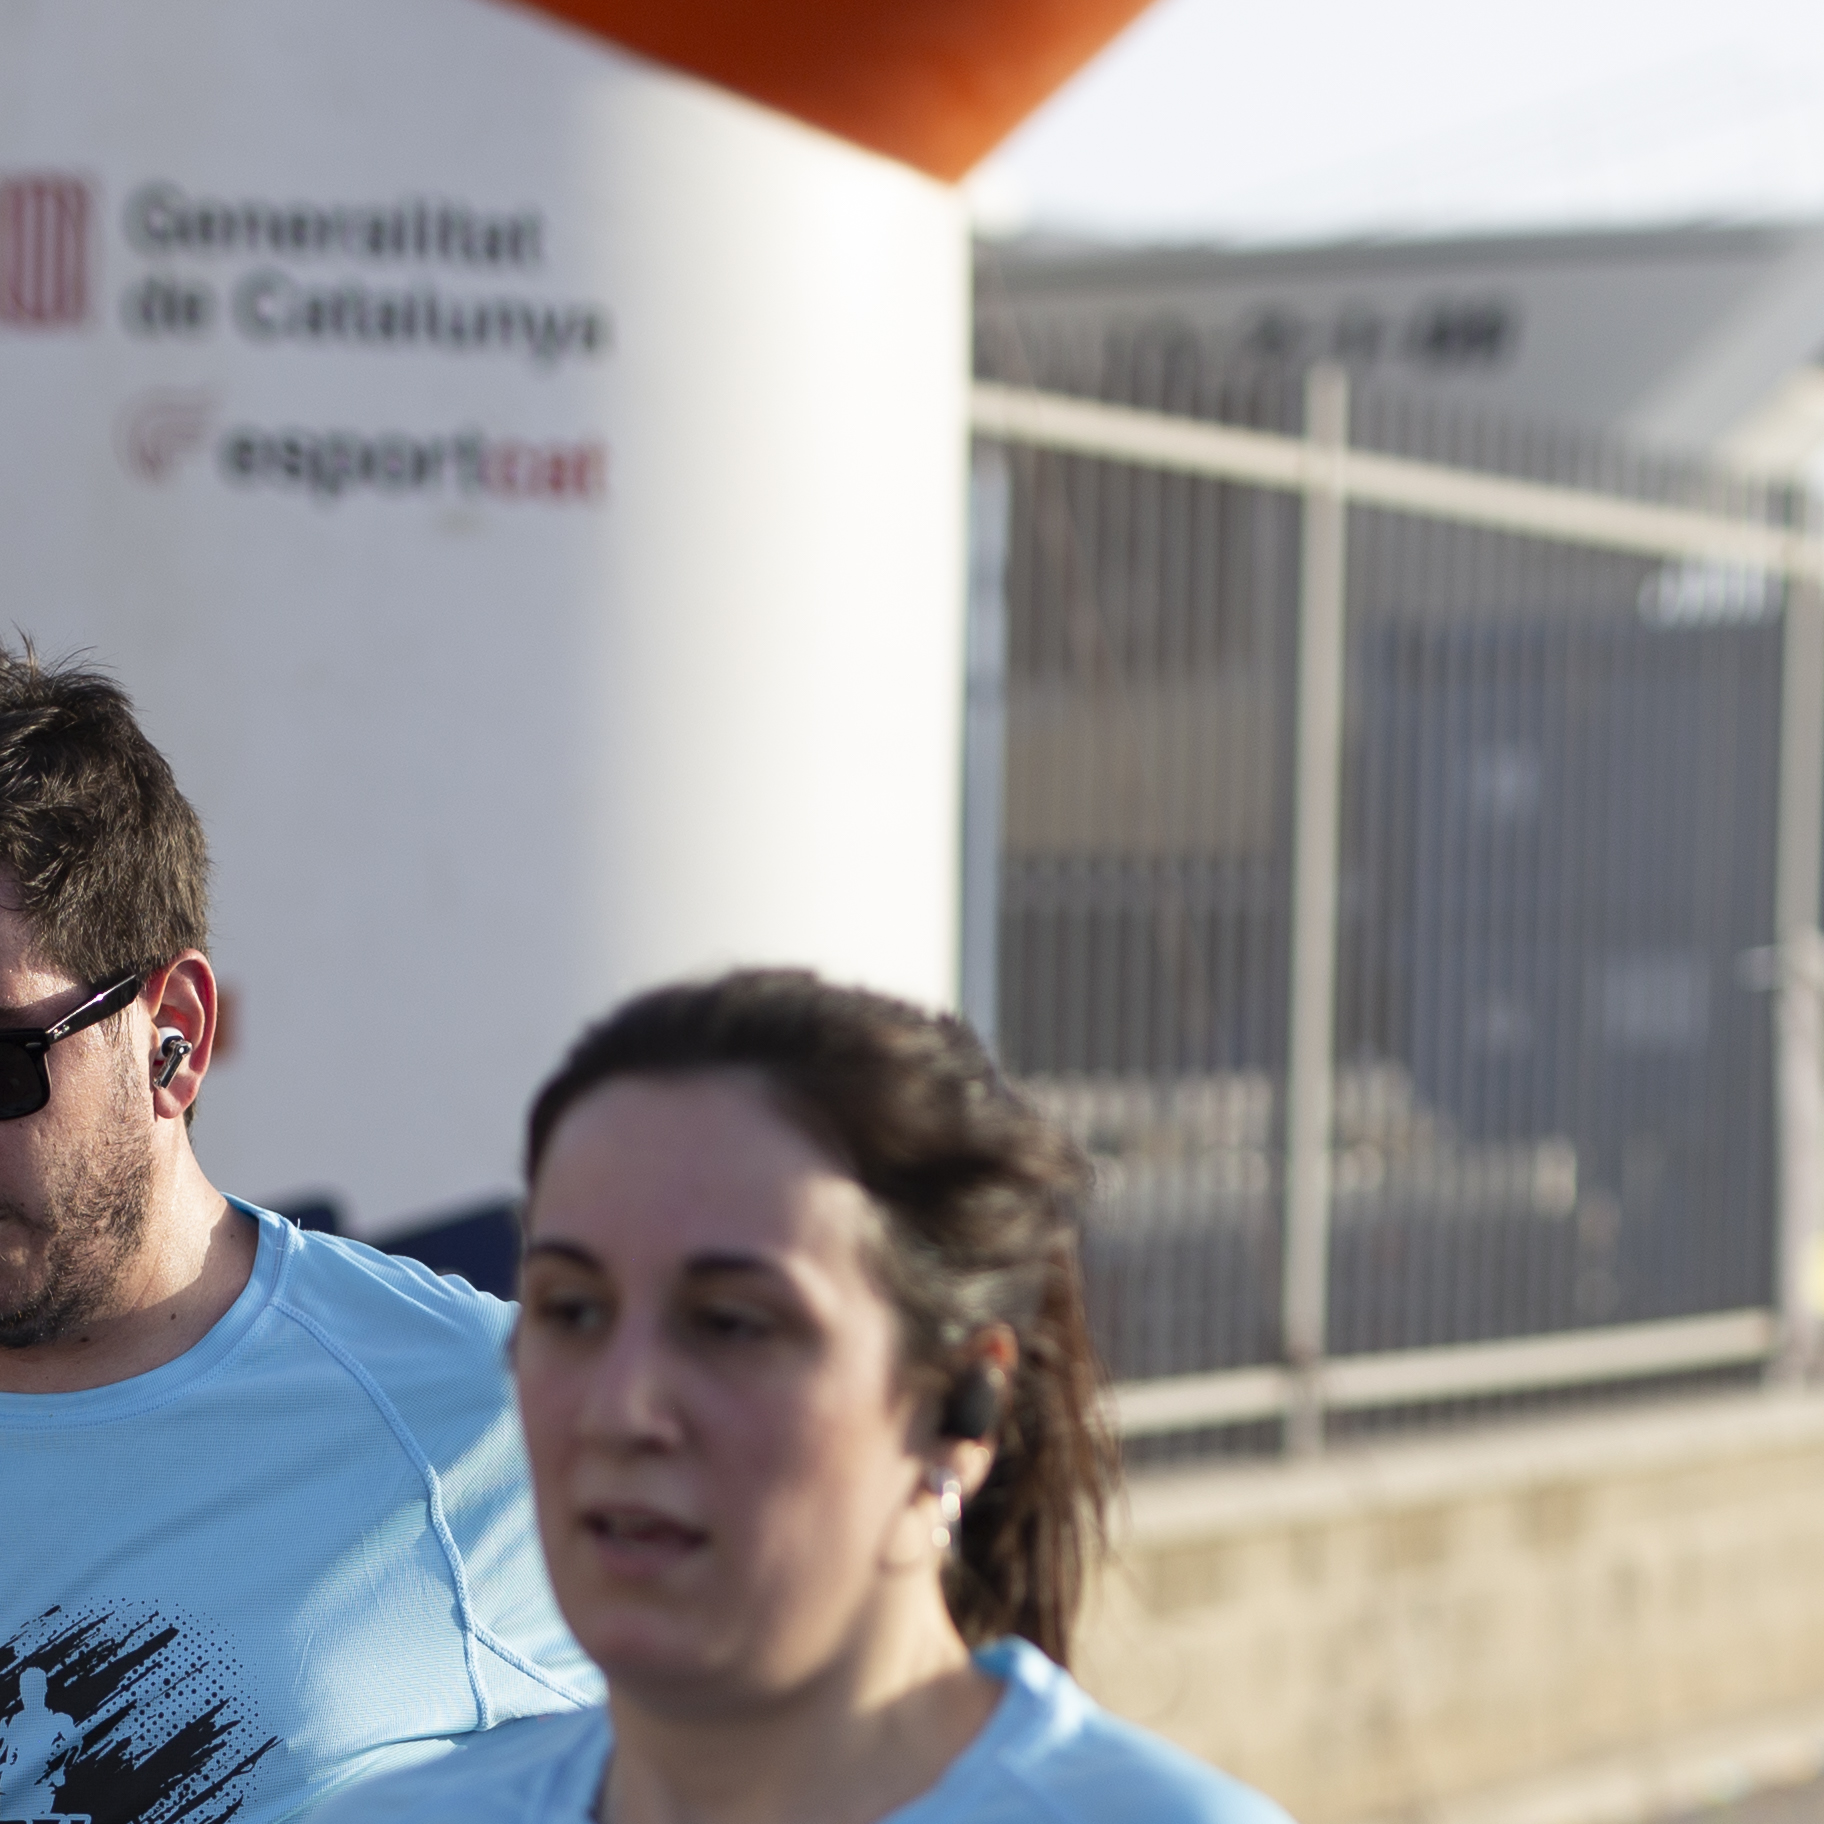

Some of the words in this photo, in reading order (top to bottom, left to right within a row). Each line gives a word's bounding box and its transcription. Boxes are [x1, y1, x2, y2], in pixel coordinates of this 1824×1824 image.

[127, 183, 544, 266] Generalitat
[236, 270, 610, 372] Catalunya
[221, 430, 608, 504] esportcat
